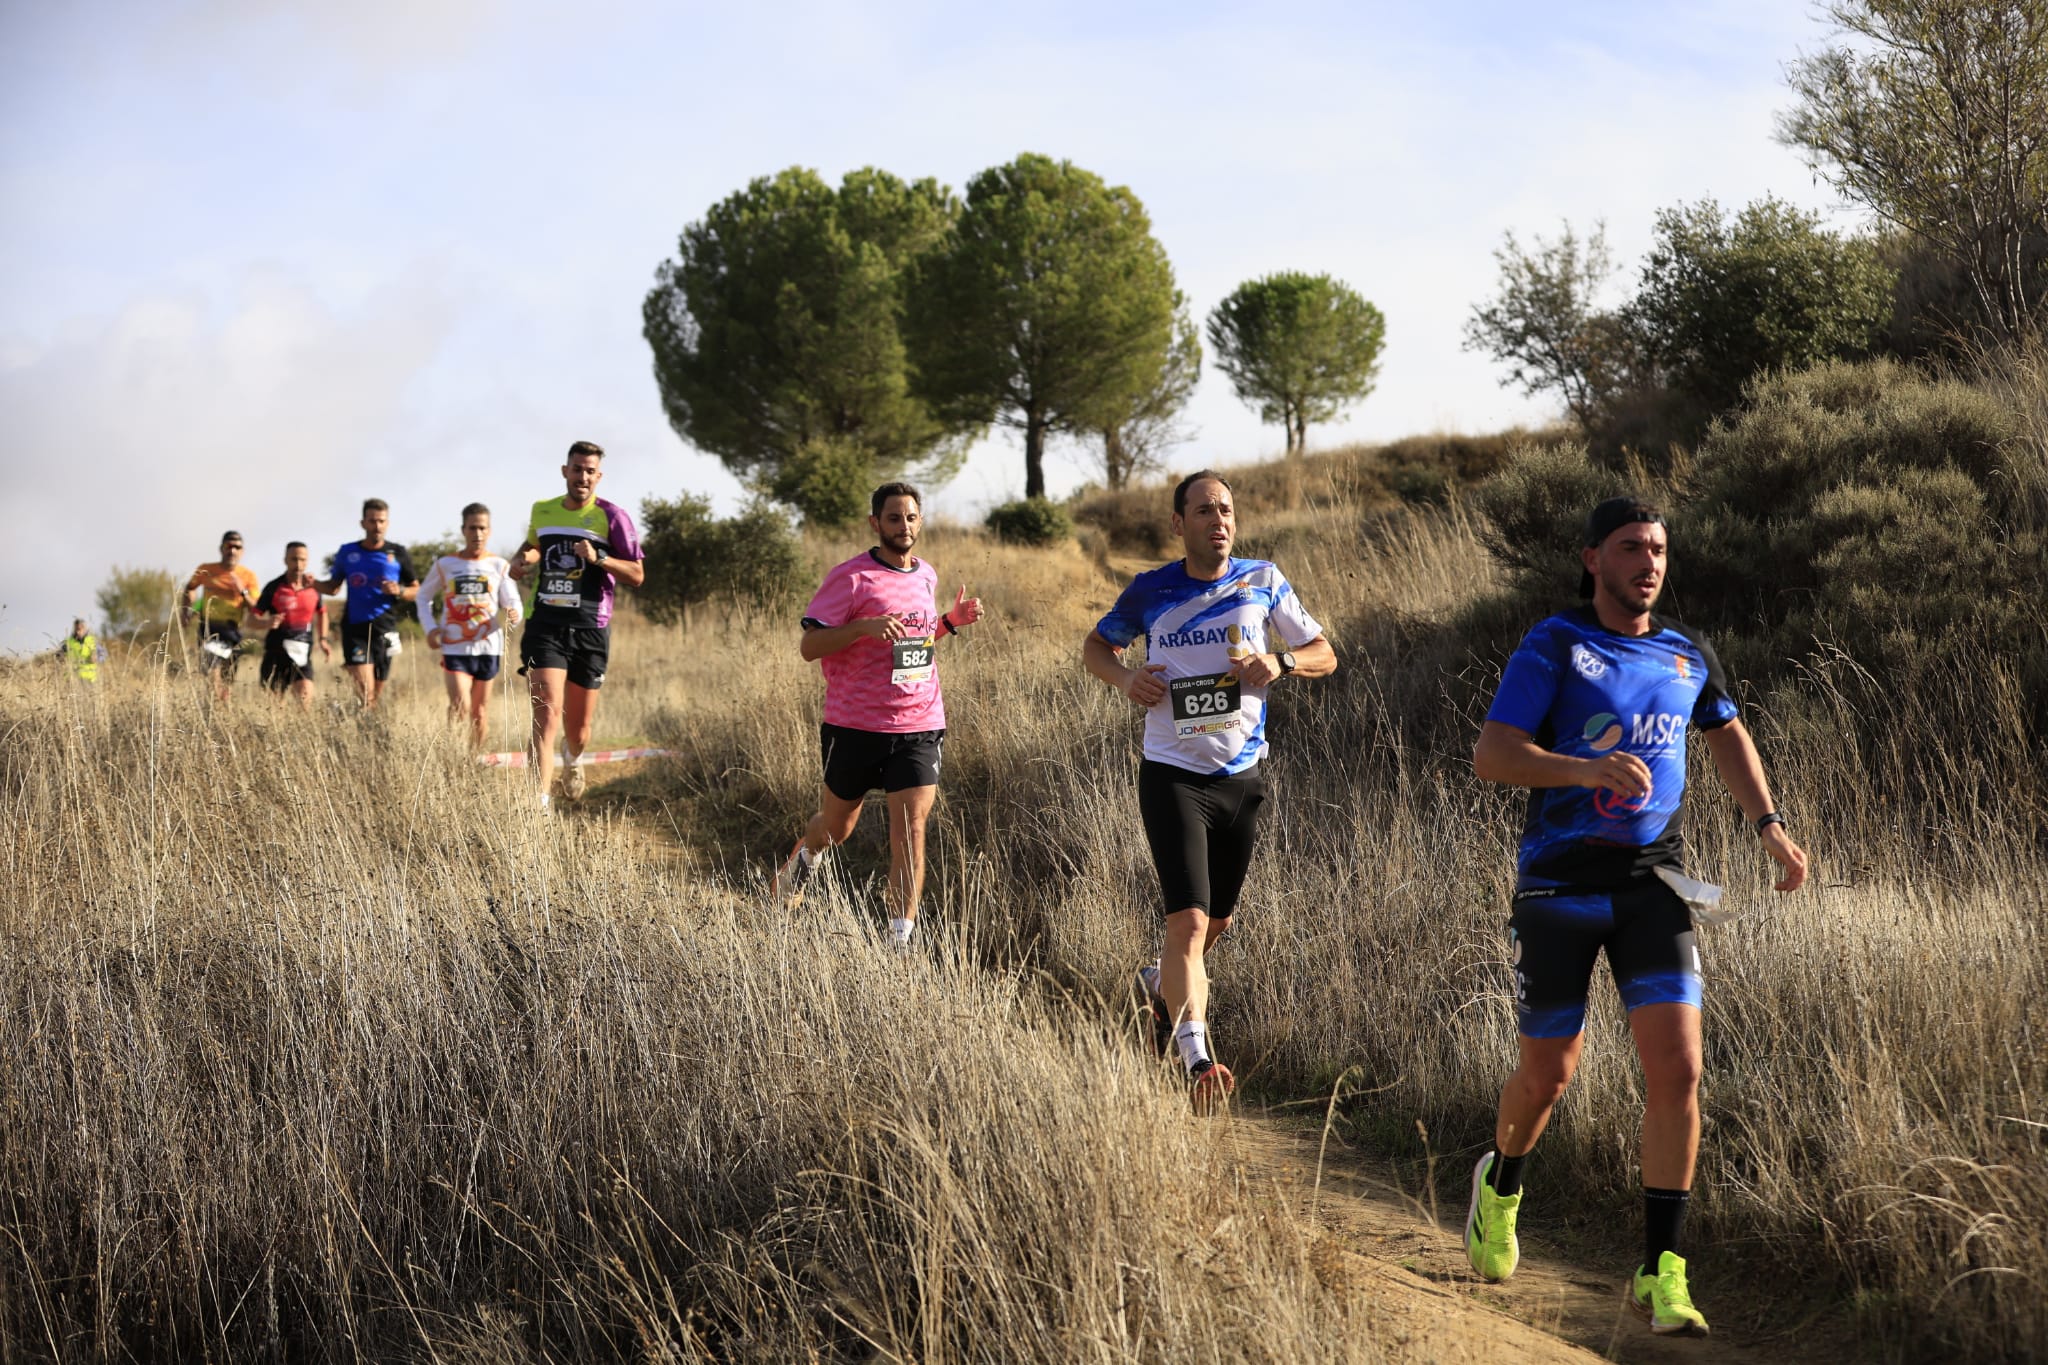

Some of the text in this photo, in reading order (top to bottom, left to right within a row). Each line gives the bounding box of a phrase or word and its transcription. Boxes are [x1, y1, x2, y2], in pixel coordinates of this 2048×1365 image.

[460, 583, 483, 593] 250
[547, 580, 573, 593] 456
[902, 650, 928, 667] 582
[1184, 691, 1229, 715] 626
[1631, 712, 1684, 746] MSC
